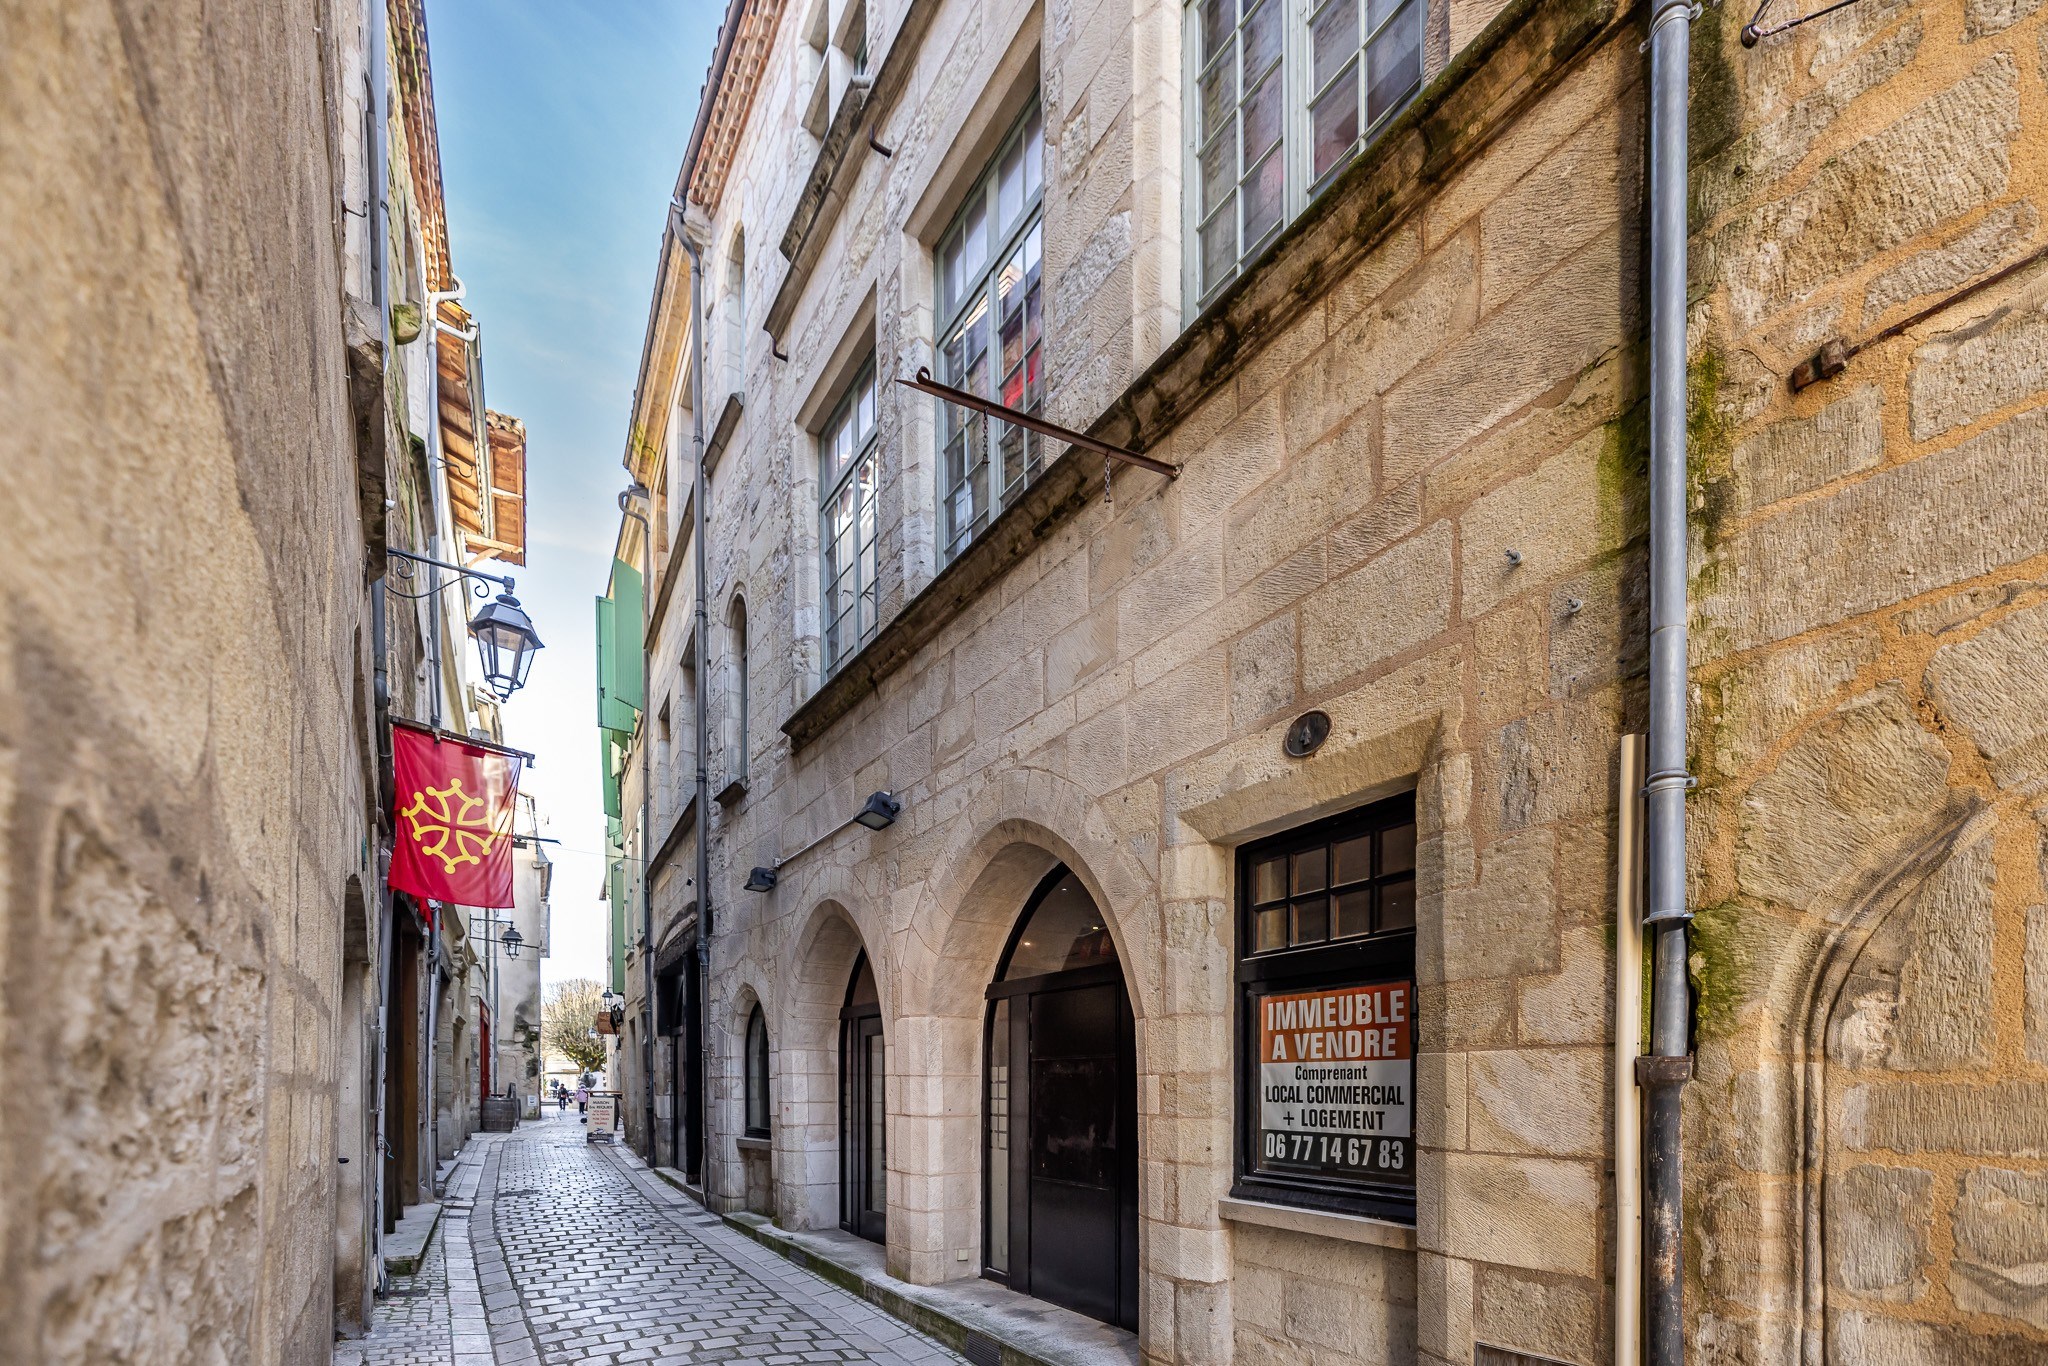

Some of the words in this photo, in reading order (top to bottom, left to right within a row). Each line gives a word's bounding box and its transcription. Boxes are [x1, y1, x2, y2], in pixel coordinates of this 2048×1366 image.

[1267, 990, 1404, 1031] IMMEUBLE
[1272, 1035, 1287, 1060] A
[1294, 1028, 1397, 1059] VENDRE
[1295, 1065, 1367, 1083] Comprenant
[1265, 1085, 1303, 1104] LOCAL
[1306, 1085, 1404, 1106] COMMERCIAL
[1283, 1111, 1295, 1126] +
[1301, 1109, 1385, 1130] LOGEMENT
[1265, 1132, 1286, 1159] 06
[1291, 1135, 1313, 1161] 77
[1320, 1136, 1342, 1164] 14
[1347, 1138, 1372, 1166] 67
[1378, 1140, 1404, 1169] 83
